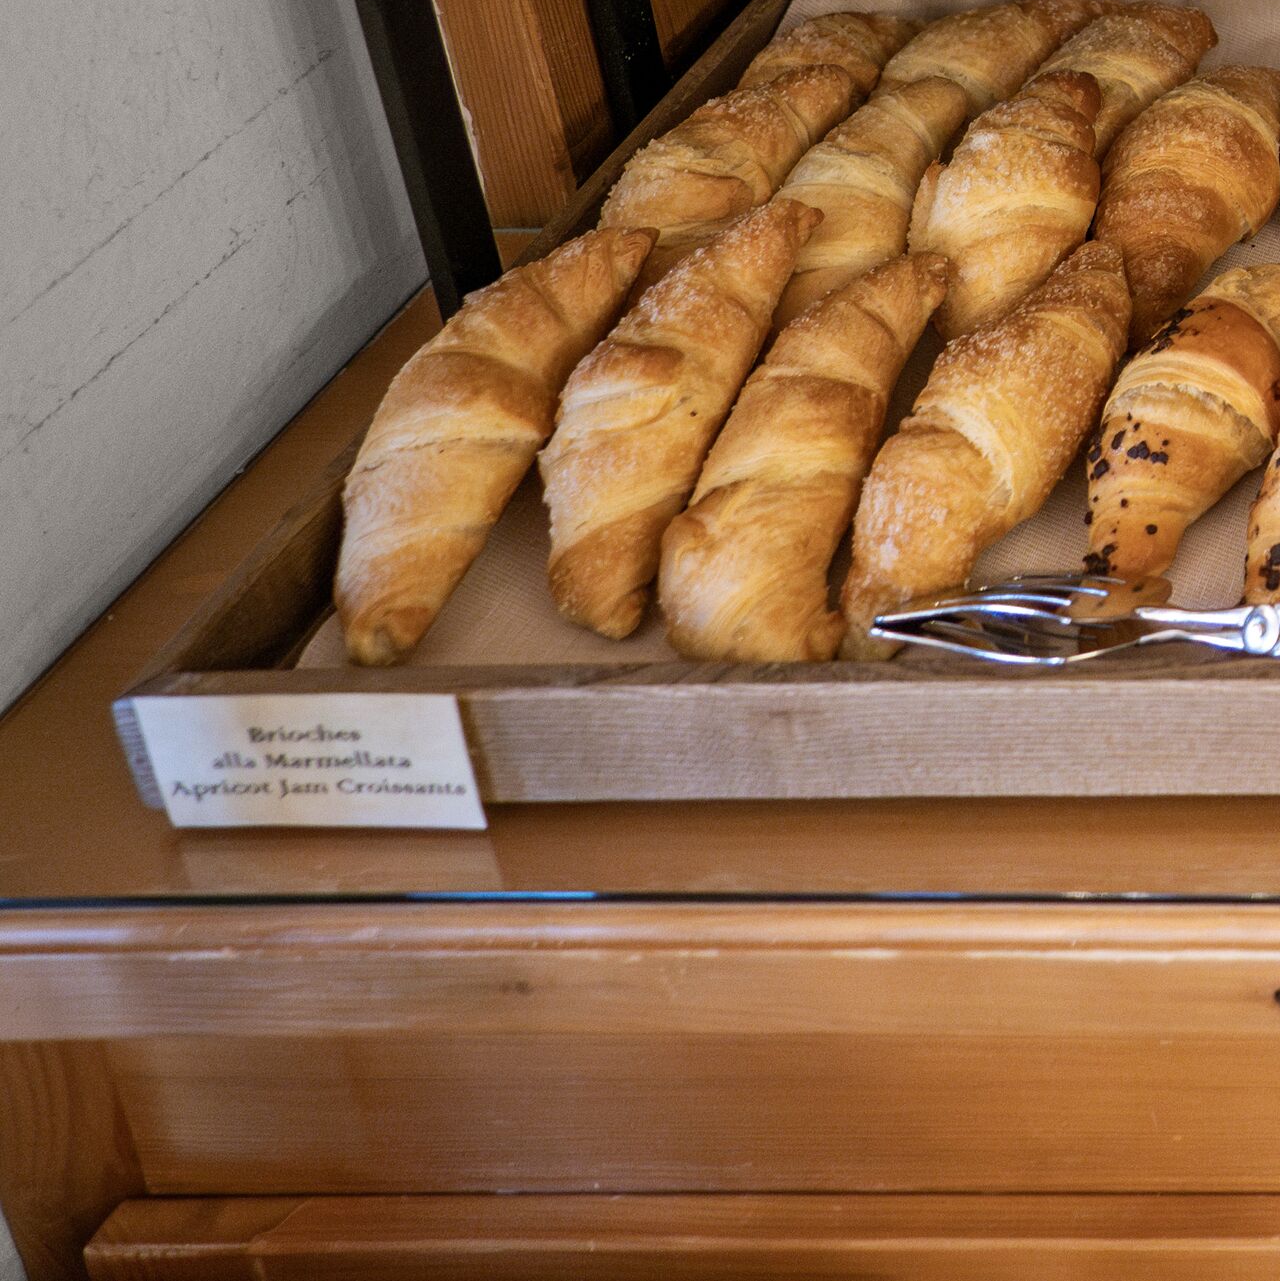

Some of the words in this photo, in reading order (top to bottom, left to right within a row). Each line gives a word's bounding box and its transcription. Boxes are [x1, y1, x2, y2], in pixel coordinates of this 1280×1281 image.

[247, 724, 362, 744] Brioches
[212, 752, 257, 770] alla
[264, 752, 412, 770] Marmellata
[172, 780, 272, 802] Apricot
[279, 779, 329, 799] Jam
[336, 777, 467, 797] Croissants
